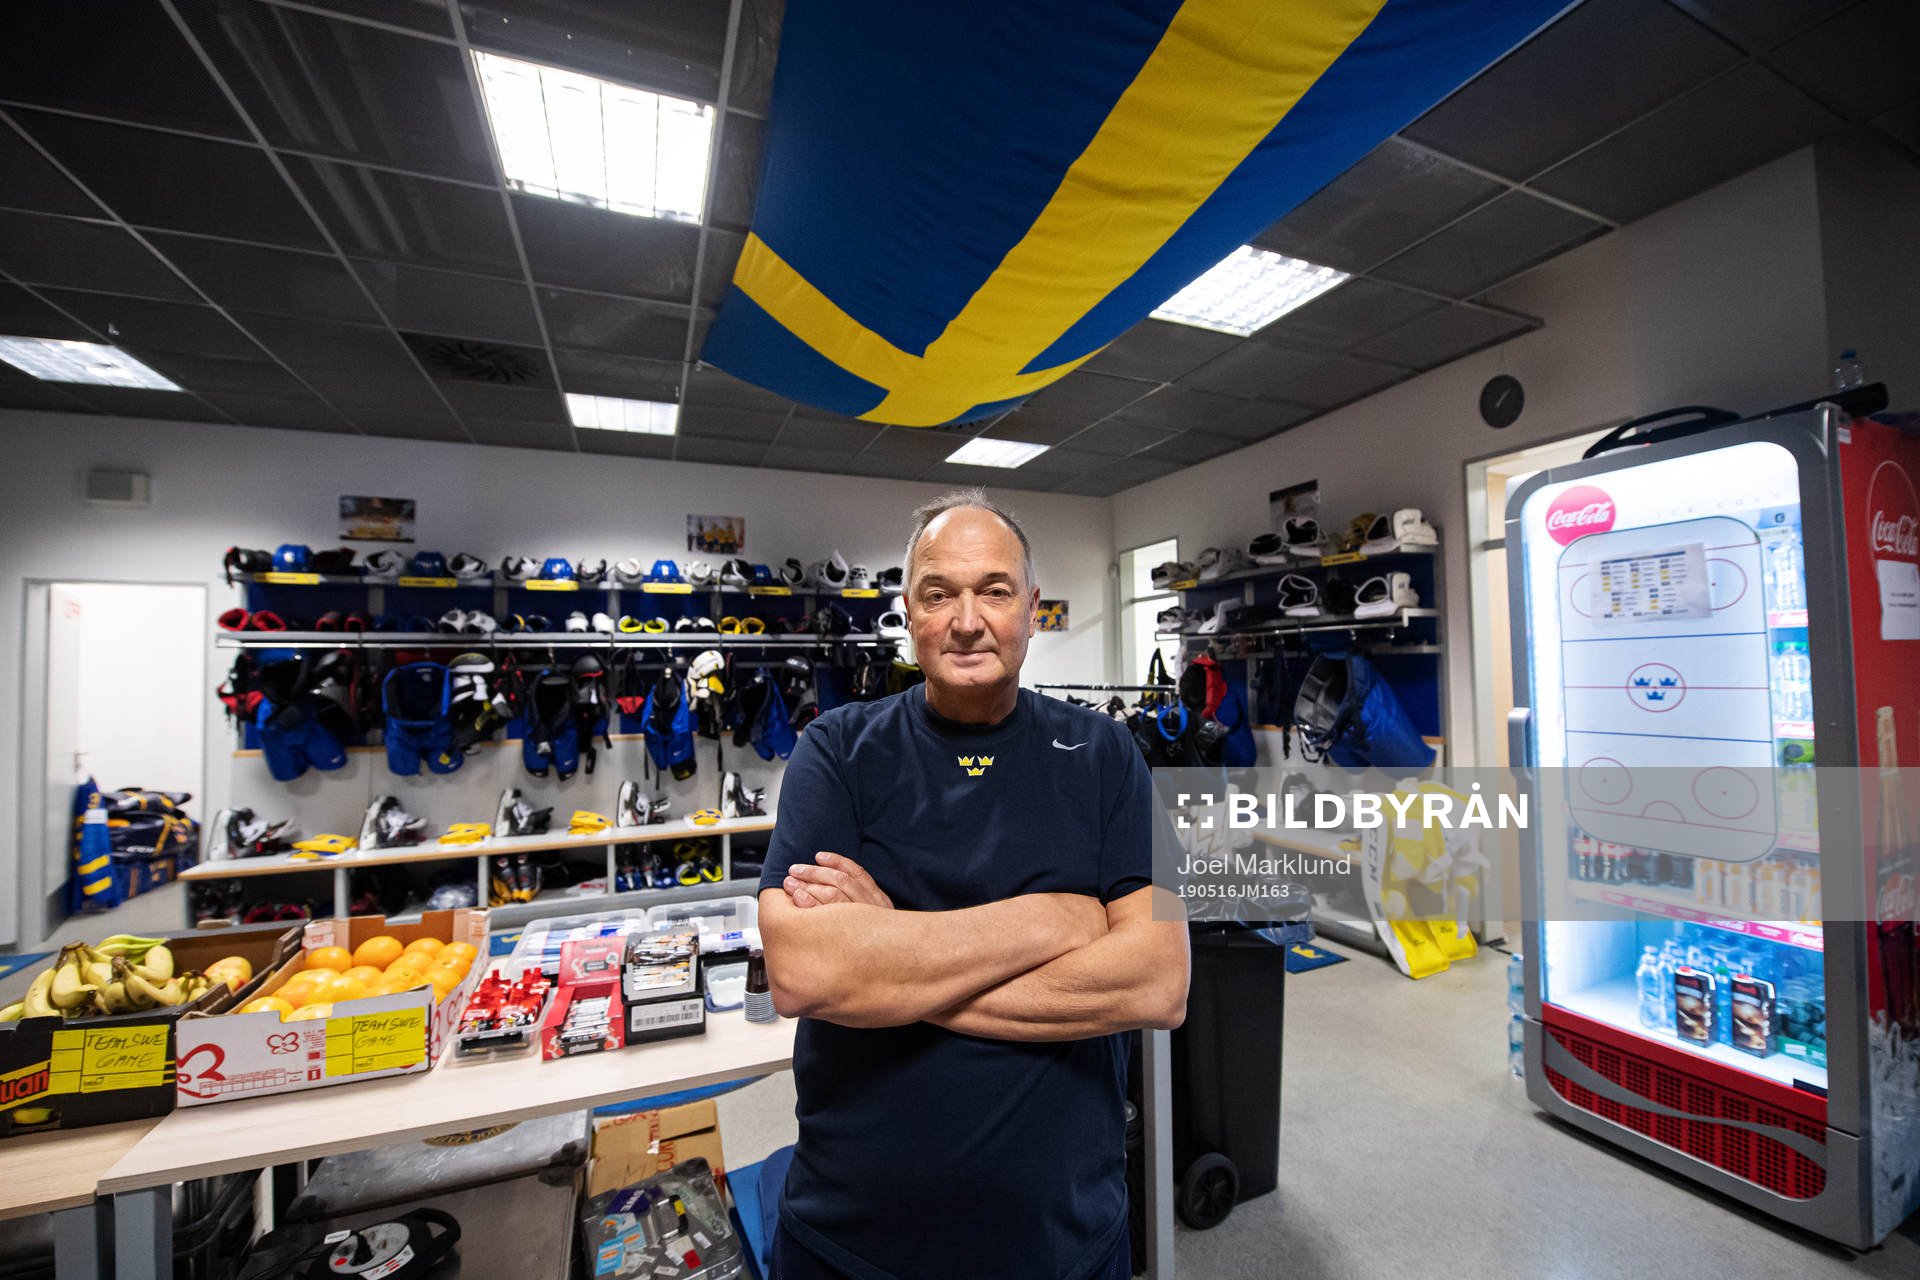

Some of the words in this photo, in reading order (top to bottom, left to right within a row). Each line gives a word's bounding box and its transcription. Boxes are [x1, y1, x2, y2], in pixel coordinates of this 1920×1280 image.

[355, 1020, 387, 1034] TEAM
[389, 1017, 421, 1031] SWE
[87, 1034, 127, 1050] TEAM
[126, 1032, 165, 1048] SWE
[355, 1033, 400, 1048] GAME
[96, 1052, 158, 1069] GAME
